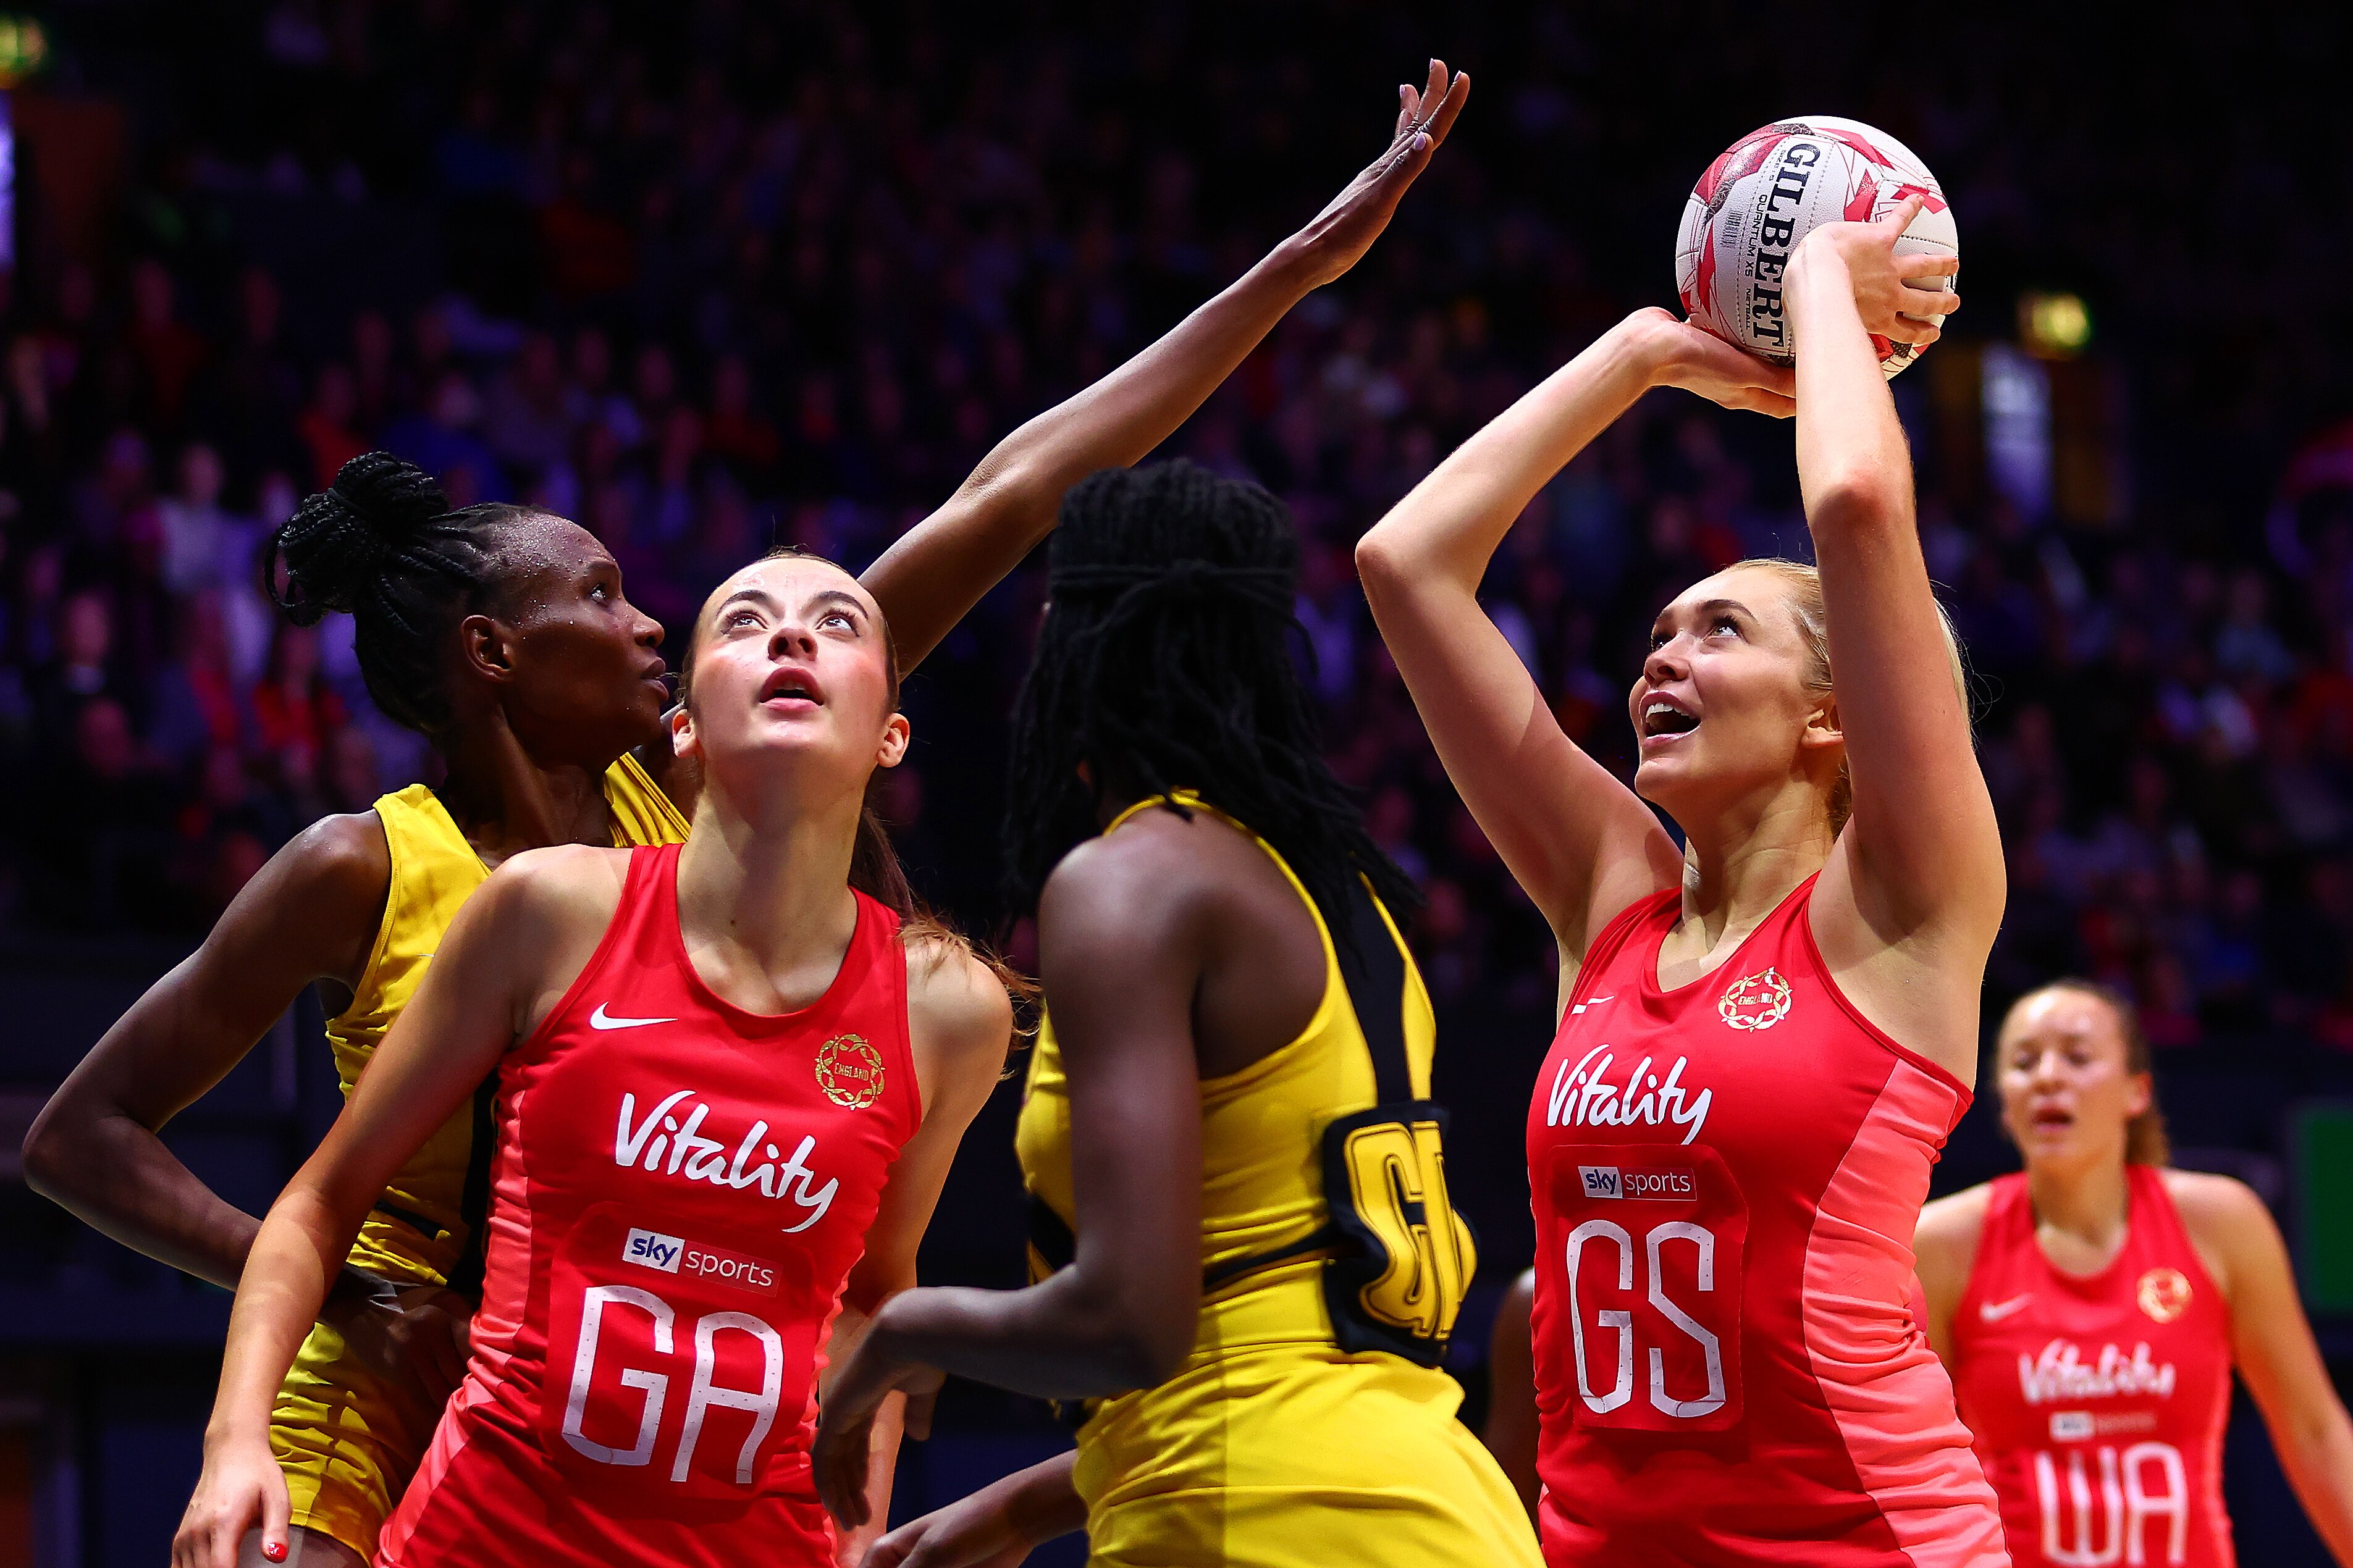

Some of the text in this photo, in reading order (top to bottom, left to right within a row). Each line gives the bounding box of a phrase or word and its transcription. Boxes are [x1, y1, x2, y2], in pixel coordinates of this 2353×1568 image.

[1747, 195, 1768, 257] QUANTUM
[1751, 143, 1820, 347] GILBERT
[1745, 260, 1754, 277] XS
[1738, 992, 1773, 1005] ENGLAND
[834, 1062, 869, 1081] ENGLAND
[1546, 1044, 1712, 1145] Vitality
[615, 1090, 839, 1233] Vitality
[1585, 1169, 1691, 1196] sky sports
[631, 1235, 774, 1286] sky sports
[1566, 1220, 1727, 1419] GS
[562, 1285, 785, 1484] GA
[2034, 1441, 2190, 1567] WA
